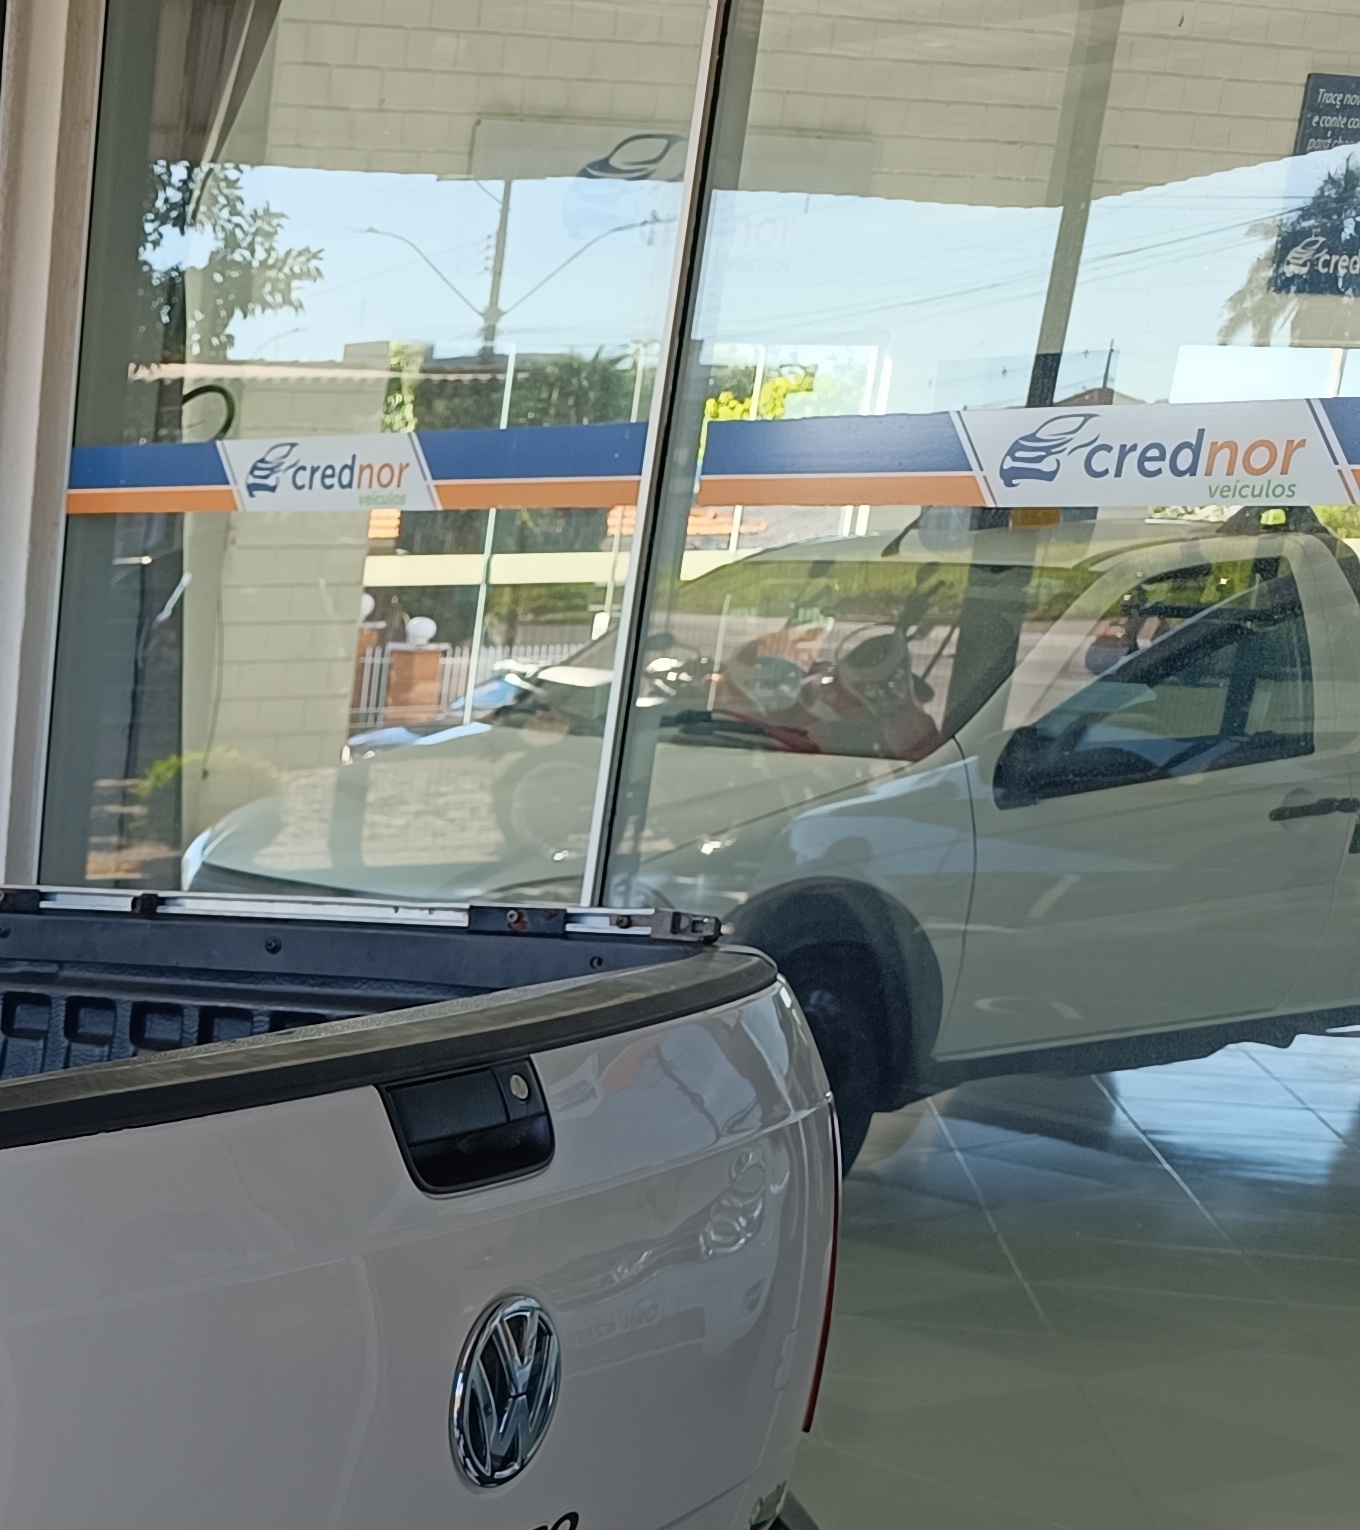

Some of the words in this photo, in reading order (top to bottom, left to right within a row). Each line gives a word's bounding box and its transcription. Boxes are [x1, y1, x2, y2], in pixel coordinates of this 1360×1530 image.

[291, 453, 411, 491] crednor
[1083, 428, 1307, 479] crednor
[1206, 478, 1297, 500] veículos
